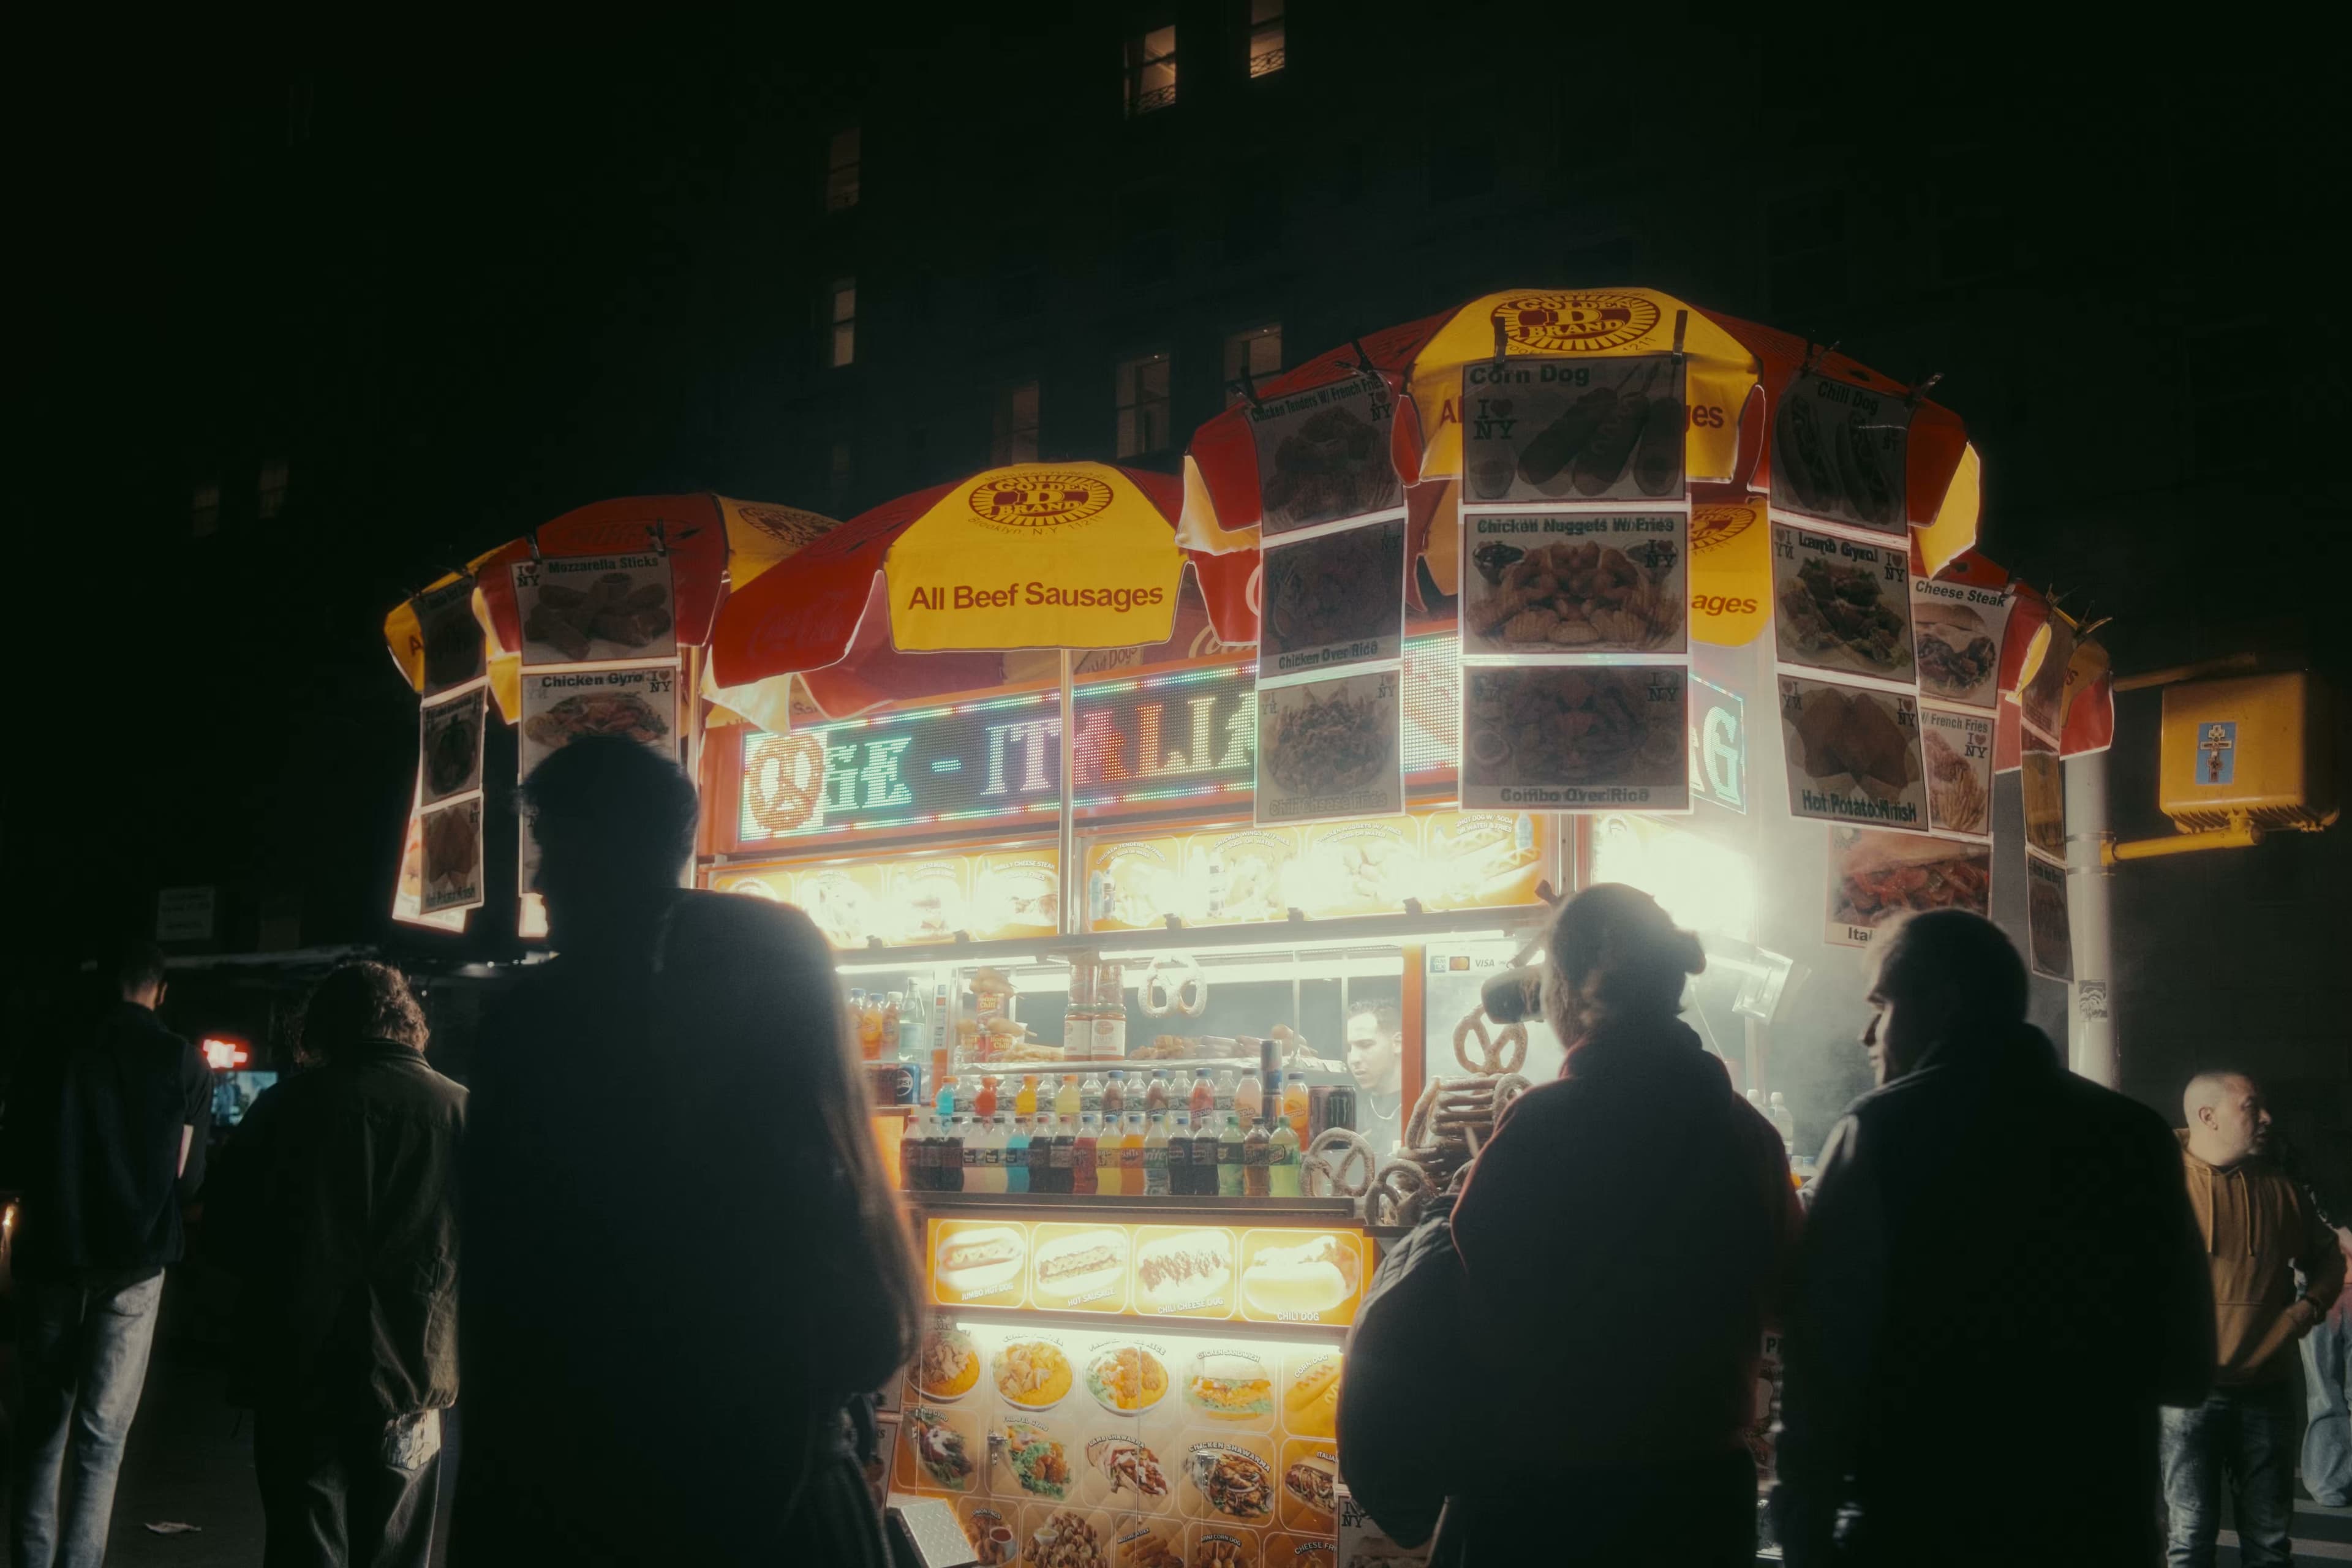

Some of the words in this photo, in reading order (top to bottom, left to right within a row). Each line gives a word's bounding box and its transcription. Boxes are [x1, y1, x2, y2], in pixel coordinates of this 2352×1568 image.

[1517, 299, 1634, 311] GOLDEN
[1526, 320, 1625, 338] BRAND
[1470, 366, 1531, 385] Corn
[1540, 364, 1591, 388] Dog
[1286, 396, 1316, 412] Tenders
[1332, 382, 1360, 402] French
[1362, 377, 1384, 393] Fries
[1817, 381, 1850, 405] Chili
[1852, 390, 1879, 417] Dog
[1370, 403, 1392, 421] NY
[1441, 396, 1464, 423] Al
[1473, 419, 1518, 440] NY
[995, 481, 1093, 491] GOLDEN
[998, 501, 1079, 515] BRAND
[1477, 518, 1538, 533] Chicken
[1543, 518, 1608, 536] Nuggets
[1635, 518, 1675, 532] Fries
[1798, 530, 1836, 554] Lamb
[548, 558, 616, 574] Mozzarella
[619, 556, 658, 570] Sticks
[518, 575, 540, 587] NY
[1885, 566, 1906, 582] NY
[908, 586, 946, 611] All
[954, 584, 1018, 610] Beef
[1025, 582, 1164, 613] Sausages
[1915, 580, 1964, 600] Cheese
[1967, 589, 2005, 608] Steak
[1691, 594, 1758, 616] ages
[1279, 653, 1319, 669] Chicken
[1322, 648, 1348, 662] Over
[541, 674, 603, 687] Chicken
[649, 680, 672, 693] NY
[1378, 684, 1396, 699] NY
[1646, 686, 1679, 702] NY
[1897, 712, 1915, 727] NY
[1931, 713, 1962, 729] French
[1965, 718, 1988, 734] Fries
[1965, 744, 1988, 759] NY
[1501, 788, 1560, 803] Combo
[1564, 787, 1605, 803] Over
[1802, 788, 1828, 813] Hot
[1830, 793, 1878, 816] Potato
[1342, 823, 1373, 832] NUGGETS
[1471, 814, 1486, 823] DOG
[1496, 814, 1513, 825] SODA
[1467, 823, 1488, 831] WATER
[1495, 823, 1513, 834] FRIES
[1215, 832, 1240, 849] CHICKEN
[1097, 846, 1118, 864] CHICKEN
[1036, 861, 1055, 870] STEAK
[1475, 959, 1495, 967] VISA
[962, 1289, 983, 1301] JUMBO
[984, 1286, 998, 1296] HOT
[999, 1282, 1014, 1293] DOG
[1068, 1297, 1080, 1307] HOT
[1082, 1287, 1116, 1303] SAUSAGE
[1158, 1304, 1177, 1314] CHILI
[1178, 1300, 1205, 1311] CHEESE
[1207, 1297, 1224, 1308] DOG
[1278, 1311, 1299, 1321] CHILI
[1300, 1312, 1320, 1322] DOG
[1196, 1348, 1224, 1360] CHICKEN
[1224, 1349, 1261, 1363] SANDWICH
[1294, 1359, 1312, 1378] CORN
[1312, 1354, 1329, 1365] DOG
[933, 1411, 949, 1422] GYRO
[1003, 1415, 1030, 1425] FALAFEL
[1088, 1436, 1106, 1447] LAMB
[1107, 1433, 1145, 1449] SHAWARMA
[1188, 1441, 1224, 1453] CHICKEN
[1226, 1442, 1272, 1473] SHAWARMA
[1341, 1513, 1364, 1528] NY
[1200, 1533, 1213, 1542] MINI
[1213, 1534, 1229, 1544] CORN
[1229, 1536, 1242, 1548] DOG
[1294, 1542, 1323, 1556] CHEESE
